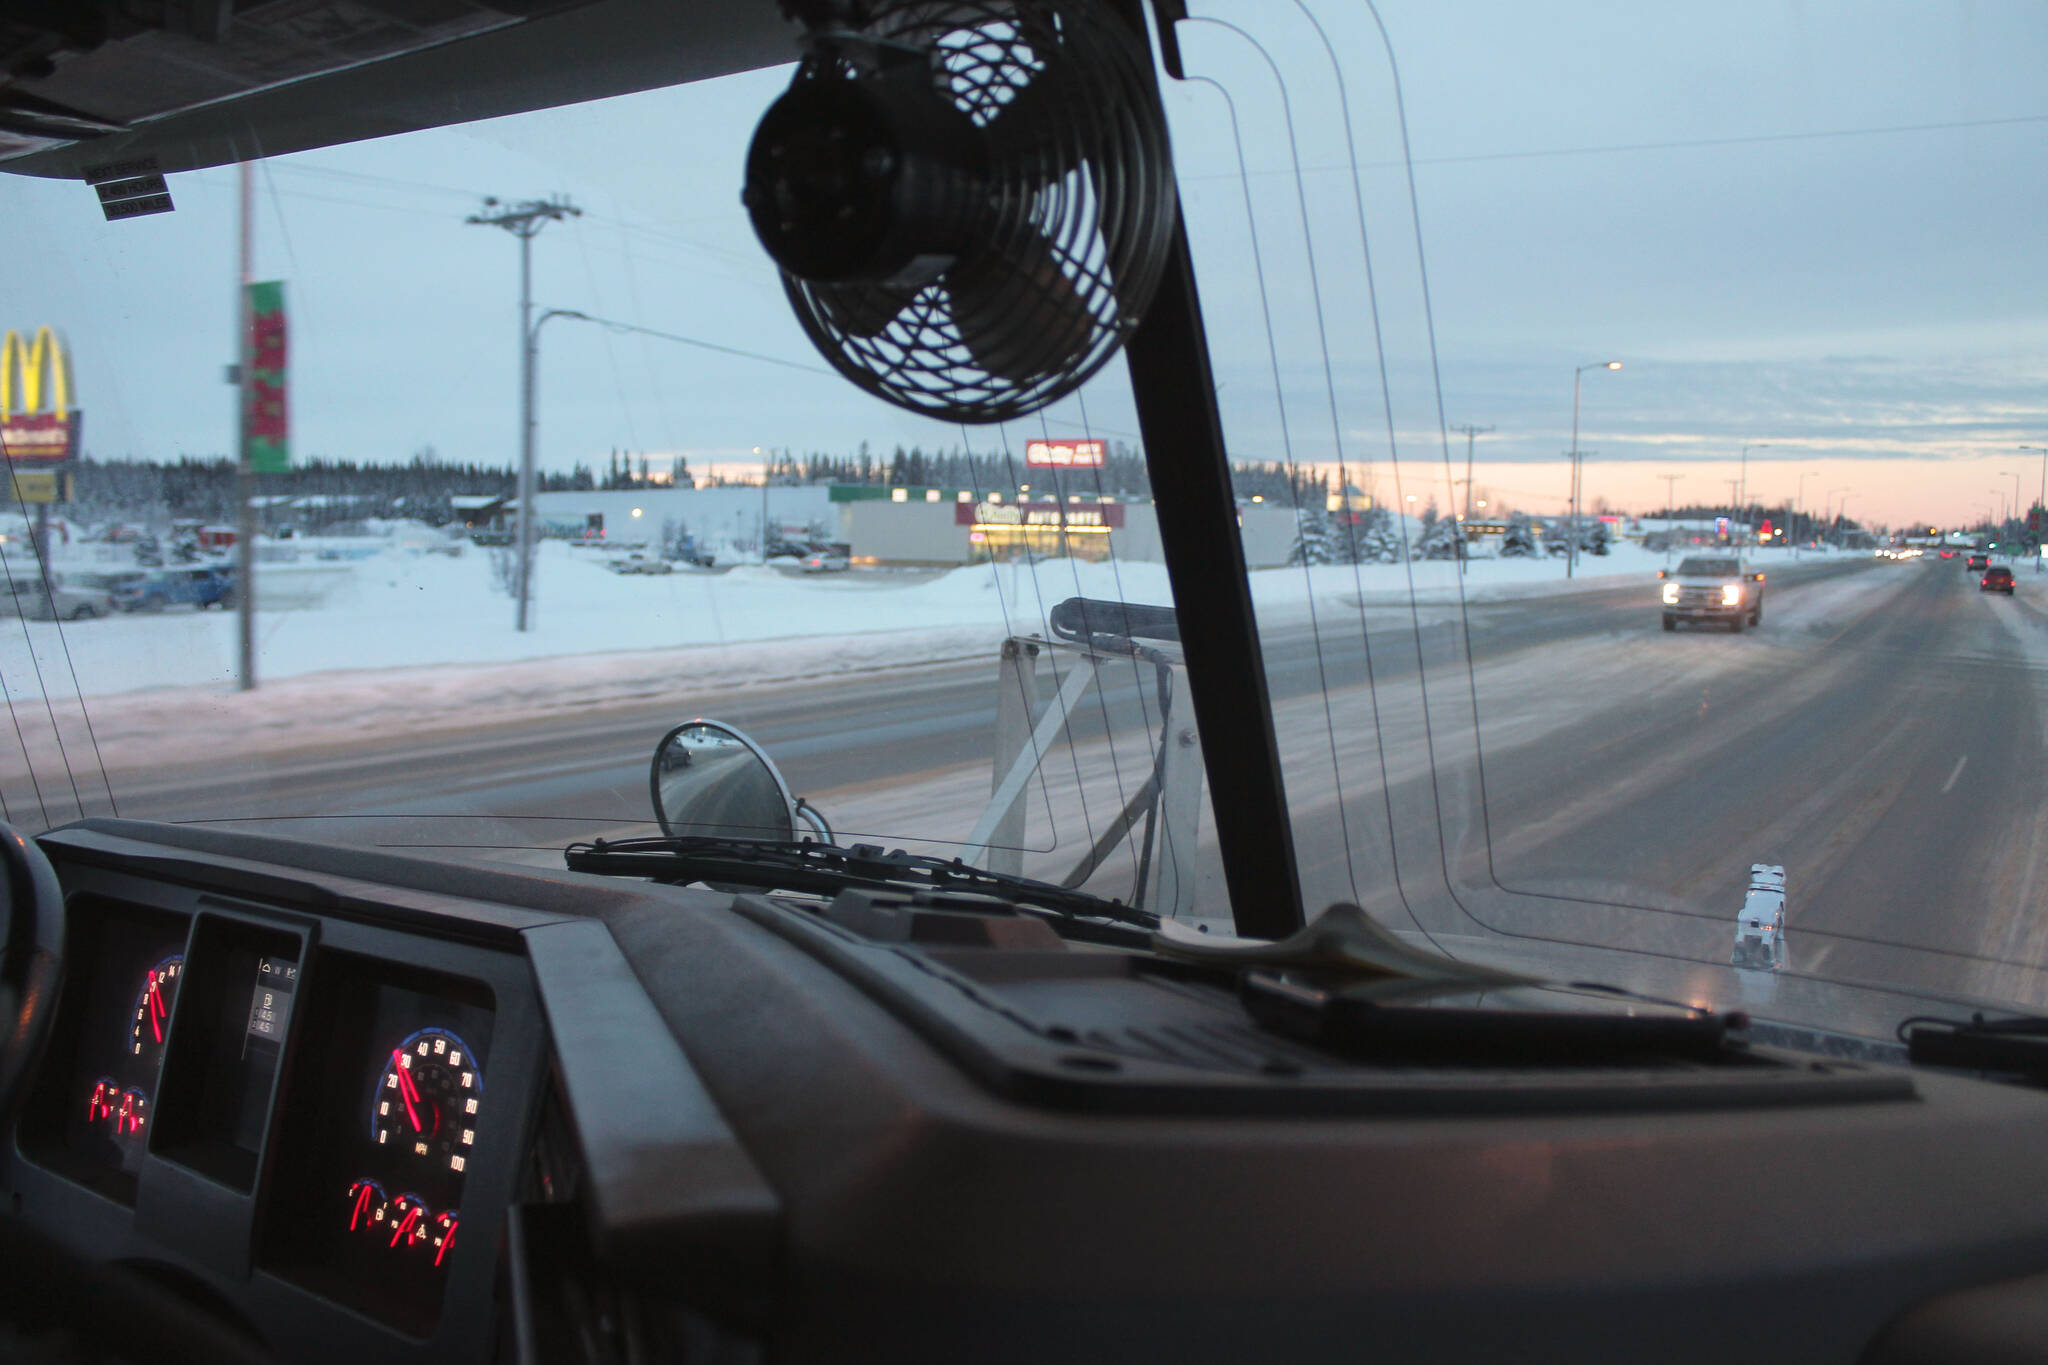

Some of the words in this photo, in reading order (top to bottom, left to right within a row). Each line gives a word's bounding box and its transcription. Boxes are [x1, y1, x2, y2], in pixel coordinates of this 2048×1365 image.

[417, 1042, 429, 1056] 40
[434, 1039, 446, 1055] 50
[400, 1054, 412, 1069] 30
[449, 1051, 462, 1066] 60
[387, 1073, 399, 1088] 20
[461, 1072, 472, 1088] 70
[380, 1101, 389, 1116] 10
[465, 1098, 478, 1115] 80
[379, 1129, 387, 1144] 0
[462, 1129, 475, 1145] 90
[451, 1155, 465, 1170] 100
